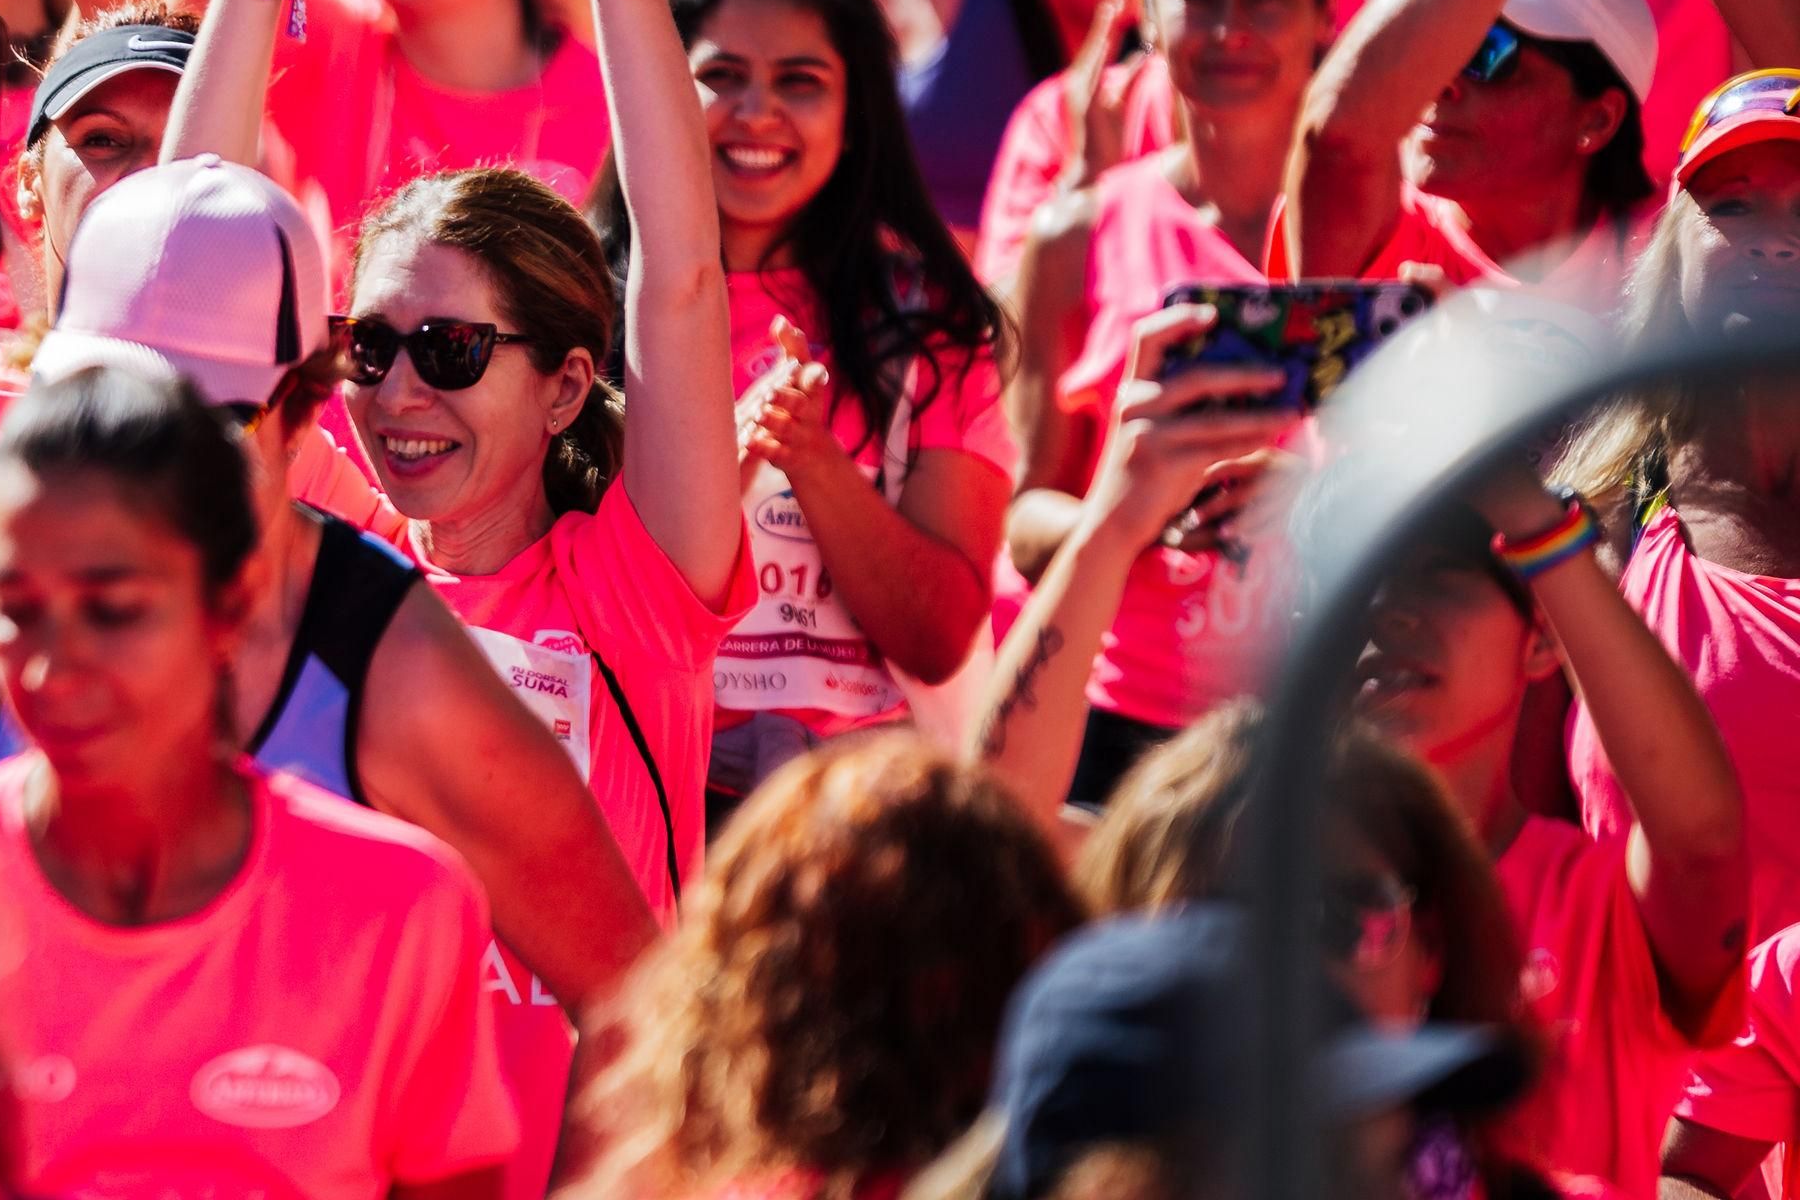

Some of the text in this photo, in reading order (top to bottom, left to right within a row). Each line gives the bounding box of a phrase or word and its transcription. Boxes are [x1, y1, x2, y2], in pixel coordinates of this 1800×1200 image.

[784, 637, 804, 651] DE
[512, 673, 568, 699] SUMA
[526, 669, 569, 687] DORSAL
[712, 671, 787, 691] OYSHO
